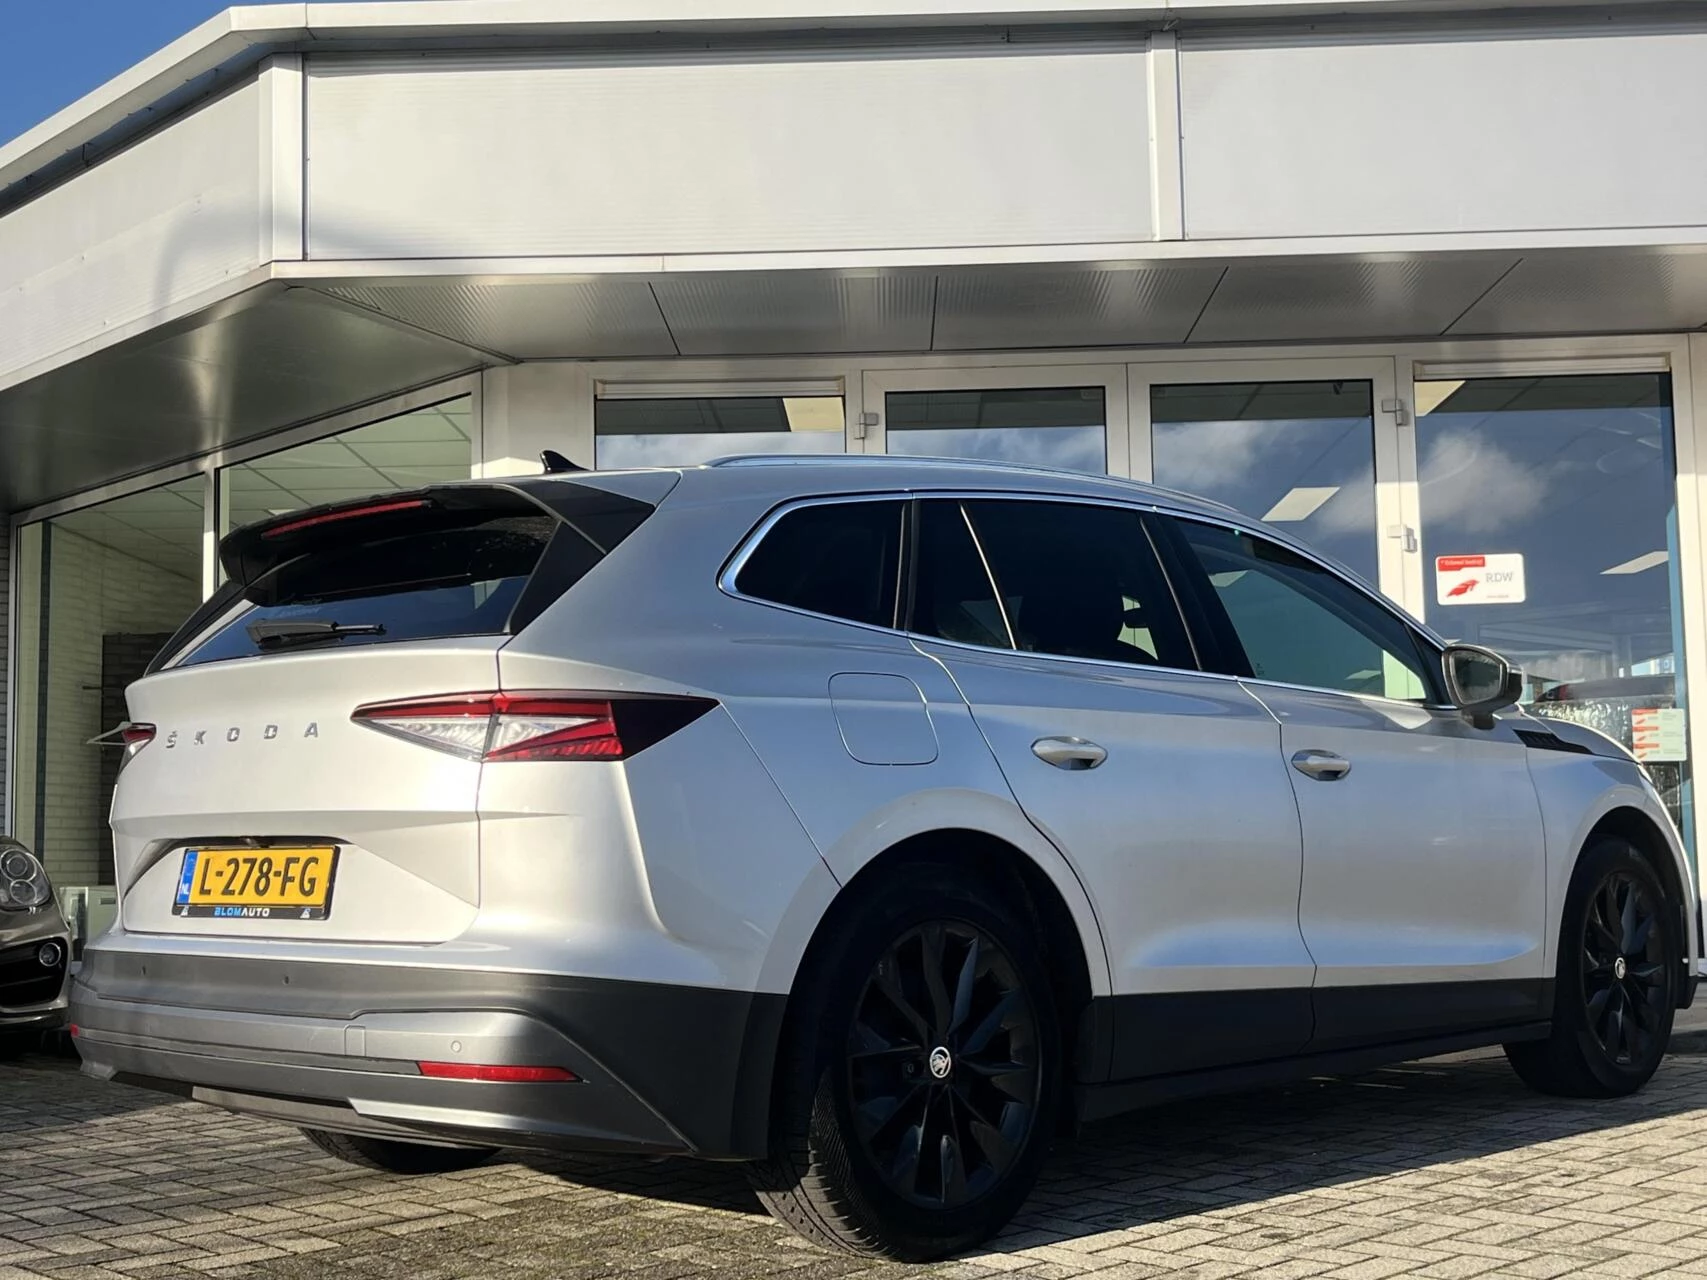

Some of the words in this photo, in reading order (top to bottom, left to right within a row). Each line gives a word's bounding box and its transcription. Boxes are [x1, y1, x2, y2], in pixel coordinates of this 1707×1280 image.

[1485, 572, 1513, 582] RDW
[199, 856, 319, 897] L-278-FG
[181, 883, 190, 894] NL
[214, 907, 270, 917] BLOMAUTO
